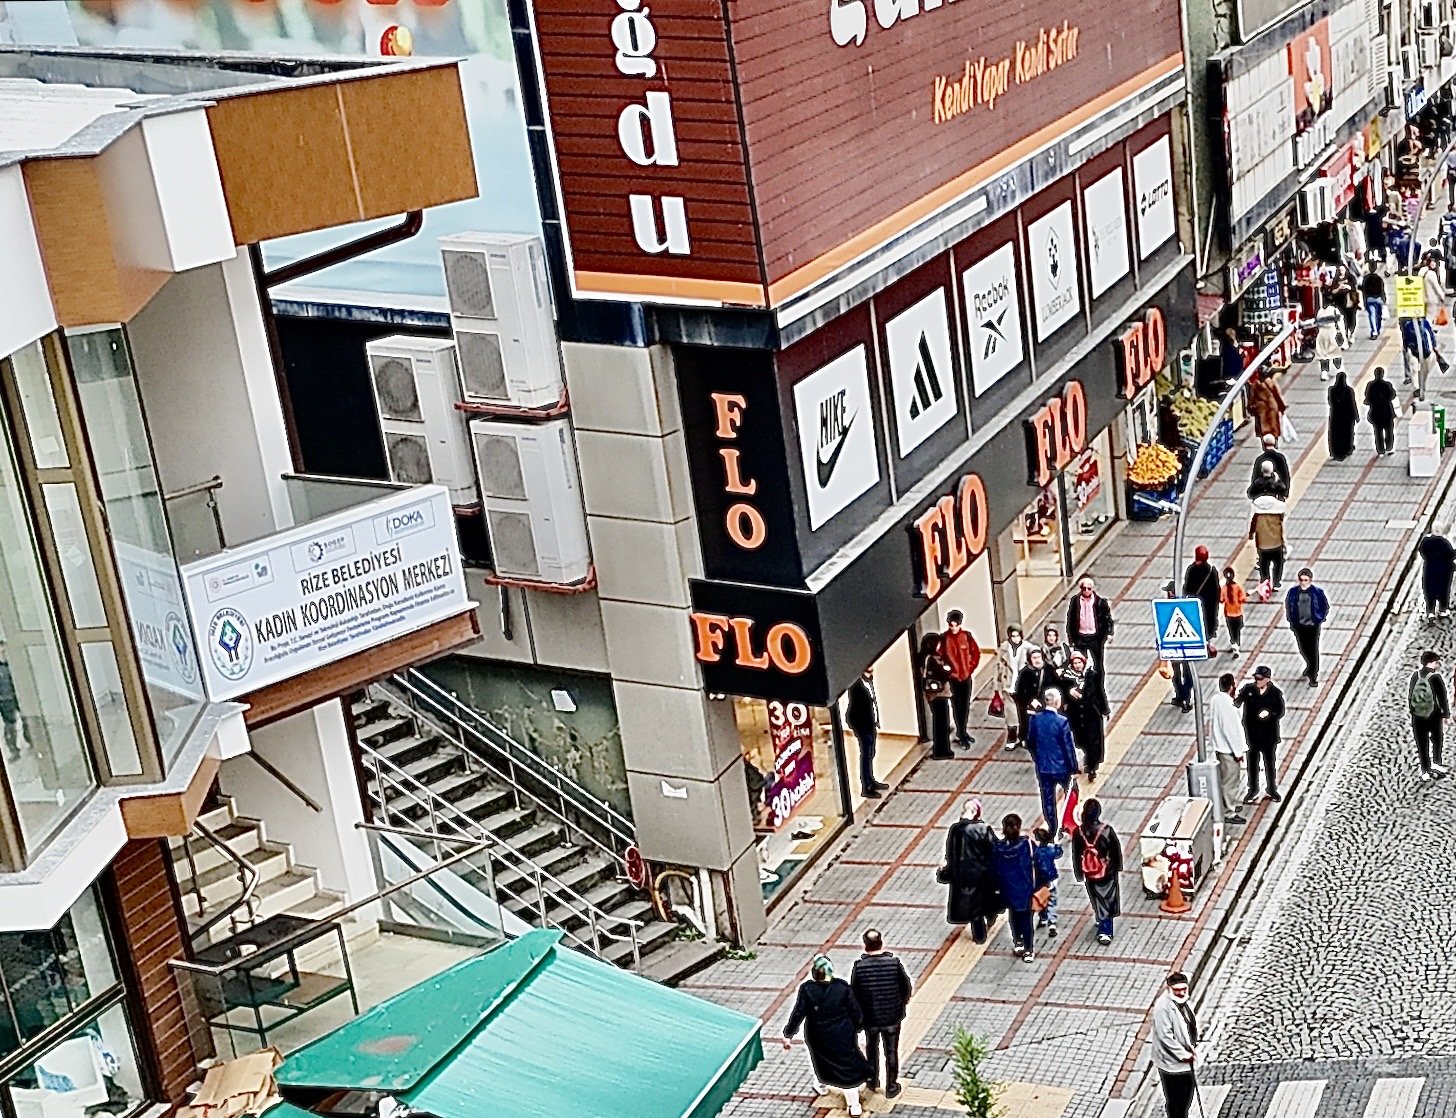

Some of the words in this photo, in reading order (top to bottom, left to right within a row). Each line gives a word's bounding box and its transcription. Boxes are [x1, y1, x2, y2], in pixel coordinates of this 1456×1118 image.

[934, 60, 974, 124] Kendi
[974, 57, 1010, 110] Yapar
[1015, 28, 1048, 84] Kendi
[1048, 19, 1078, 70] Satar
[1148, 179, 1169, 209] LOTTO
[973, 276, 1009, 320] Reebok
[1123, 306, 1166, 399] FLO
[818, 388, 847, 448] NIKE
[1030, 379, 1089, 487] FLO
[711, 393, 767, 550] FLO
[392, 510, 424, 530] DOKA
[913, 473, 989, 599] FLO
[254, 607, 298, 644] KADIN
[300, 571, 400, 628] KOORDİNASYON
[402, 547, 454, 591] MERKEZİ
[300, 572, 329, 596] RİZE
[332, 542, 402, 584] BELEDİYESİ
[690, 610, 813, 675] FLO
